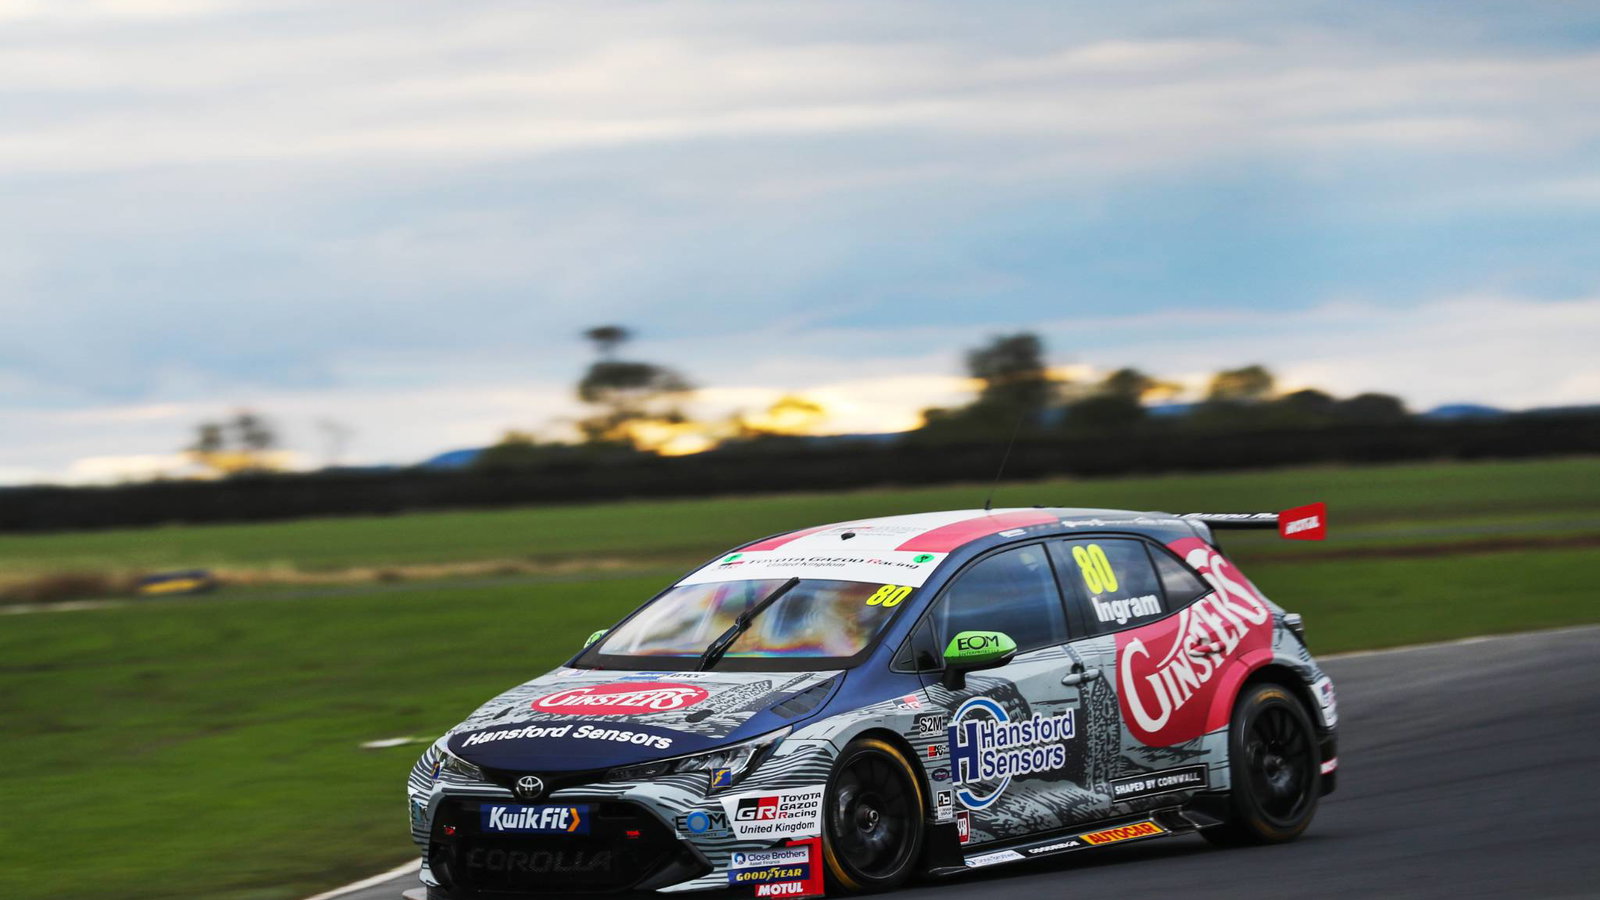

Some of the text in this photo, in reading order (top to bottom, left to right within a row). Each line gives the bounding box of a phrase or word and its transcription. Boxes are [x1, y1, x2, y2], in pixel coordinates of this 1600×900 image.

[808, 556, 865, 564] GAZOO
[866, 558, 919, 570] Racing
[1072, 543, 1118, 595] 80
[866, 583, 913, 608] 80
[1092, 594, 1162, 625] Ingram
[957, 635, 999, 651] EOM
[920, 717, 943, 733] S2M
[981, 710, 1074, 749] Hansford
[461, 724, 673, 750] Hansford Sensors
[982, 746, 1064, 777] Sensors
[1114, 781, 1145, 795] SHAPED
[1145, 779, 1156, 790] BY
[780, 792, 822, 803] TOYOTA
[737, 805, 777, 821] GR
[779, 801, 818, 811] GAZOO
[675, 811, 727, 834] EOM
[778, 810, 817, 819] Racing
[740, 821, 815, 834] United Kingdom
[1086, 823, 1154, 845] AUTOCAR
[748, 849, 806, 862] Close Brothers
[758, 882, 804, 896] MOTUL
